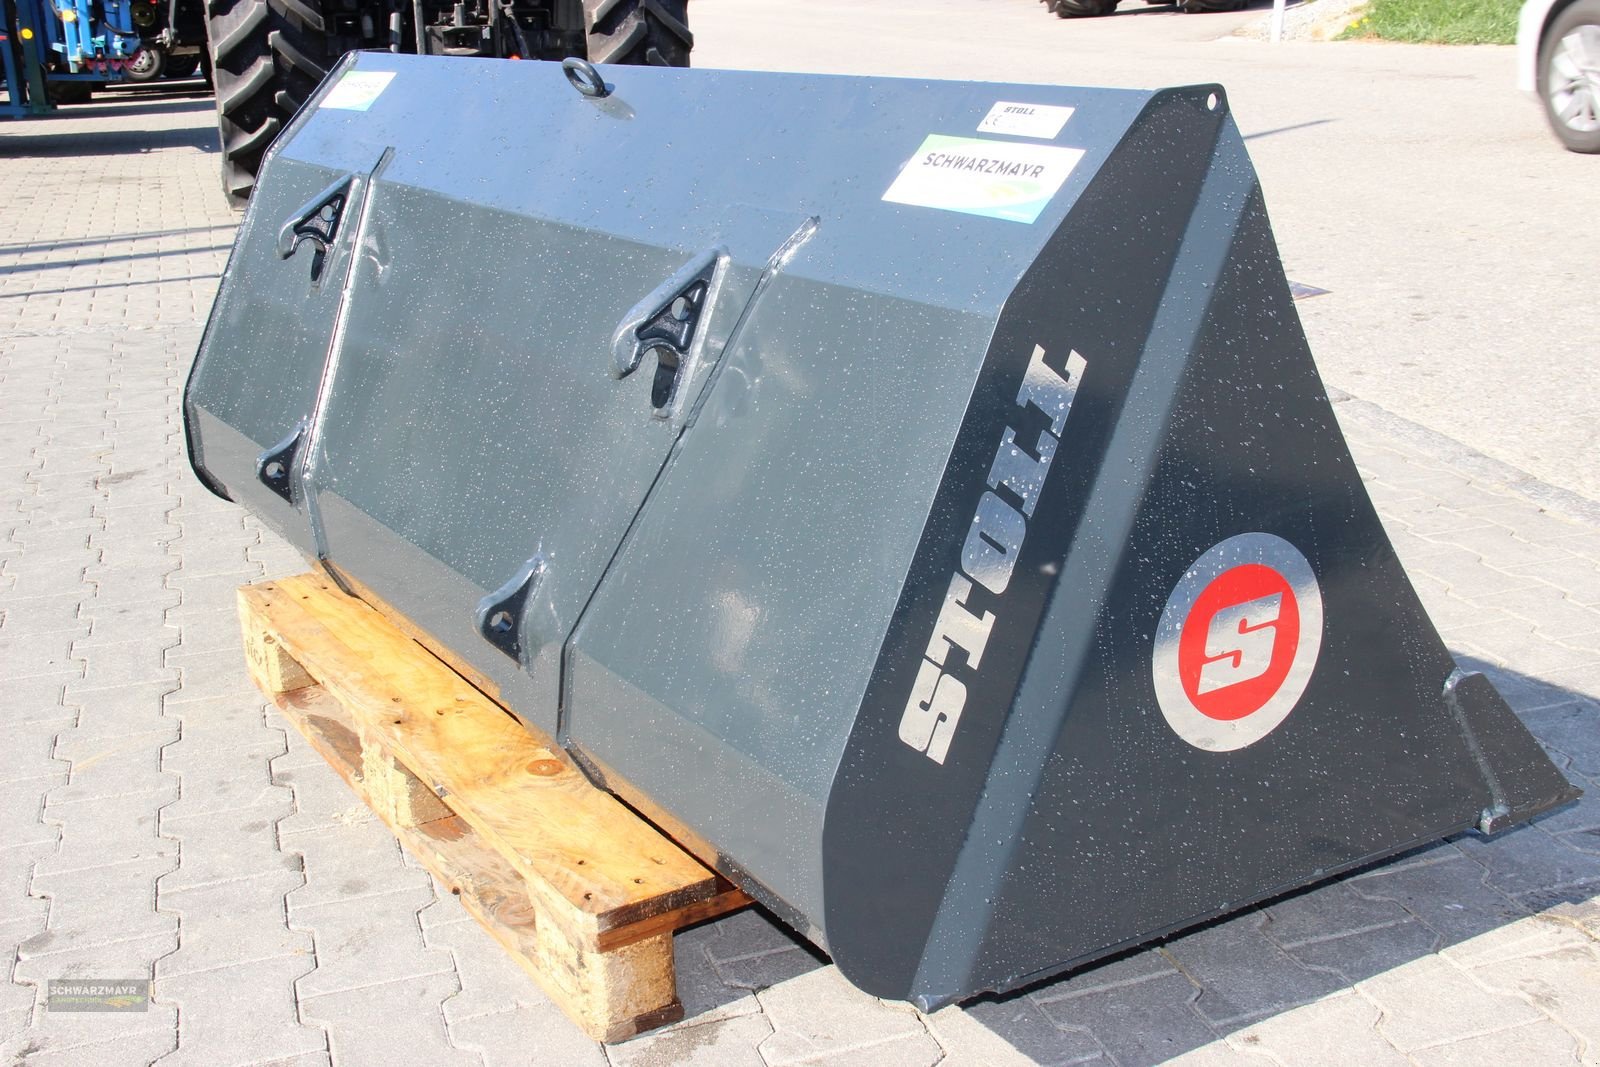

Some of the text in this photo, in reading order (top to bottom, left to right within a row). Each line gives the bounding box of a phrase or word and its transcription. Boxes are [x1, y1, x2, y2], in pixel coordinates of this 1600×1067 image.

[1004, 106, 1036, 115] STOLL
[922, 152, 1045, 178] SCHWARZMAYR
[898, 343, 1088, 766] STOLL
[1197, 591, 1283, 696] S
